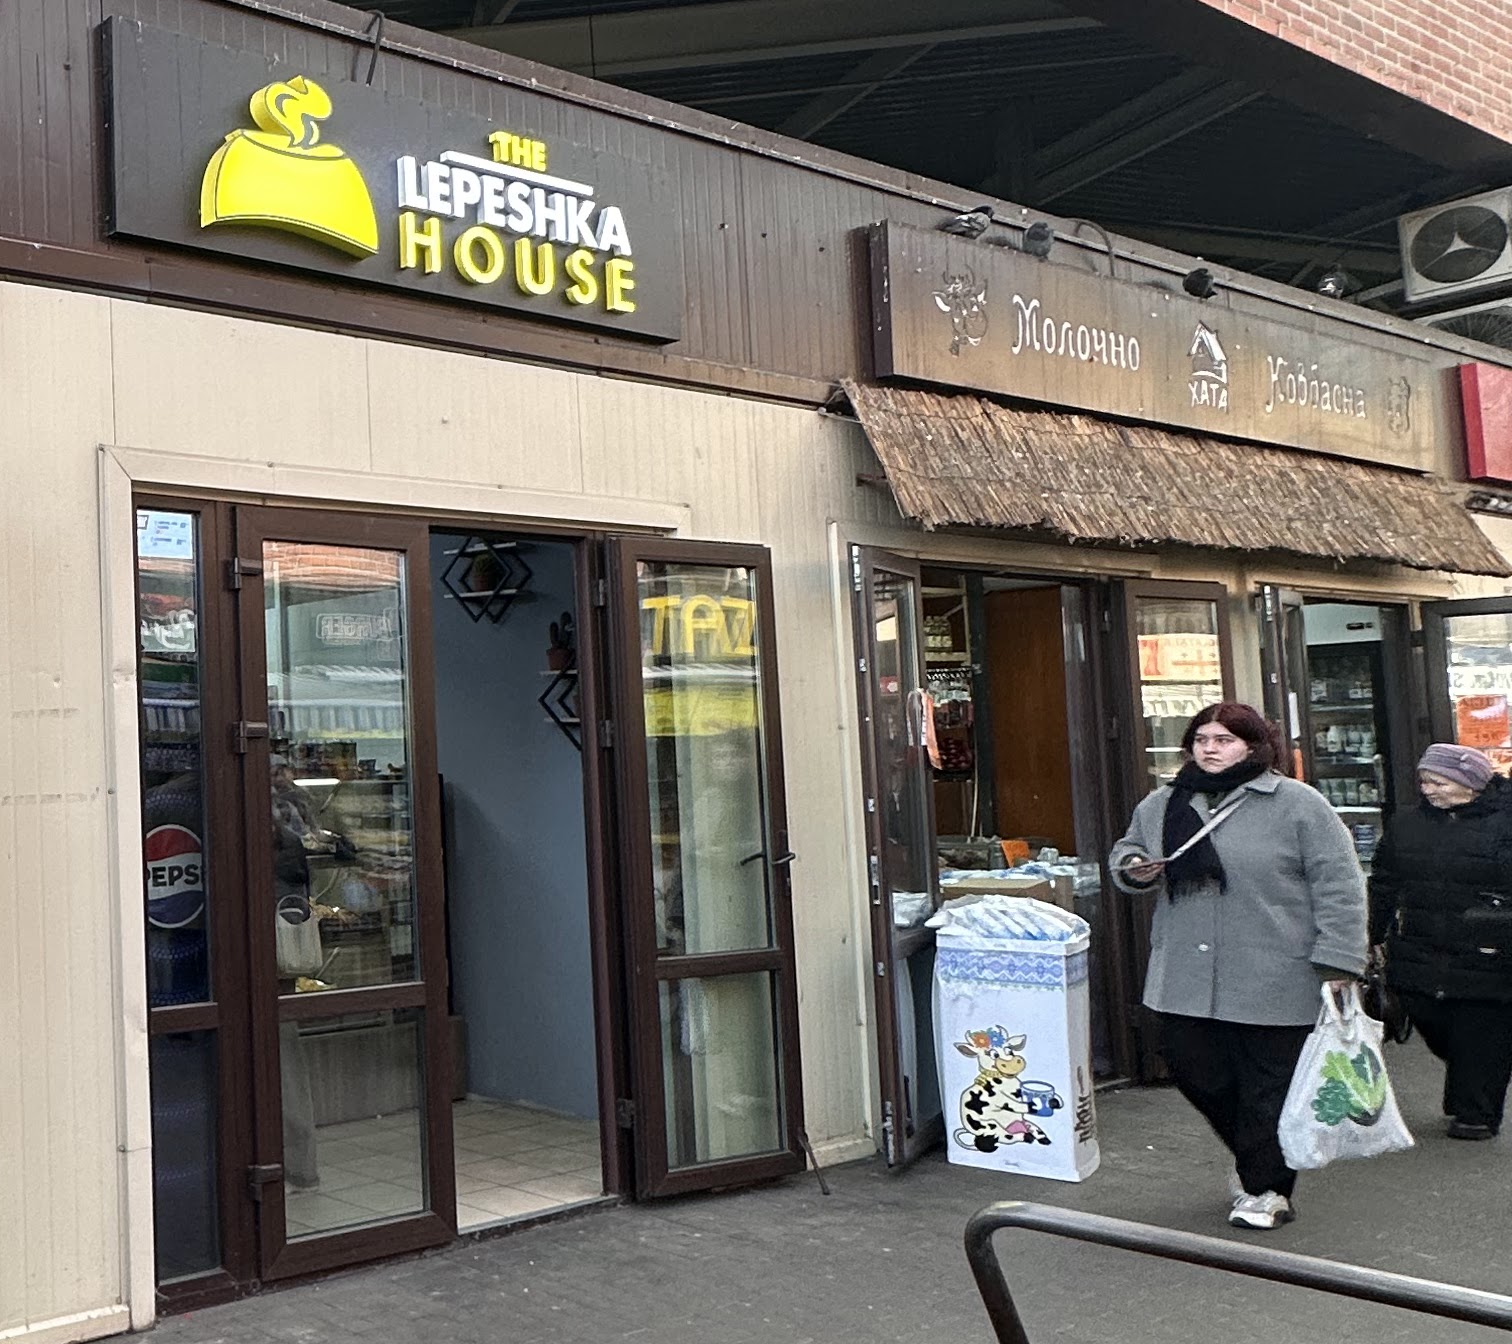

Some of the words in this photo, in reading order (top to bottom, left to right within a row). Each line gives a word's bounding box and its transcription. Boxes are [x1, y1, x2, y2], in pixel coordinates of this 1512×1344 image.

[487, 130, 547, 172] THE
[396, 154, 633, 256] LEPESHKA
[398, 210, 637, 313] HOUSE
[1011, 294, 1141, 372] Молочно
[1265, 354, 1367, 420] Ковбасна
[1187, 379, 1229, 414] ХАТА
[146, 863, 203, 888] EPS
